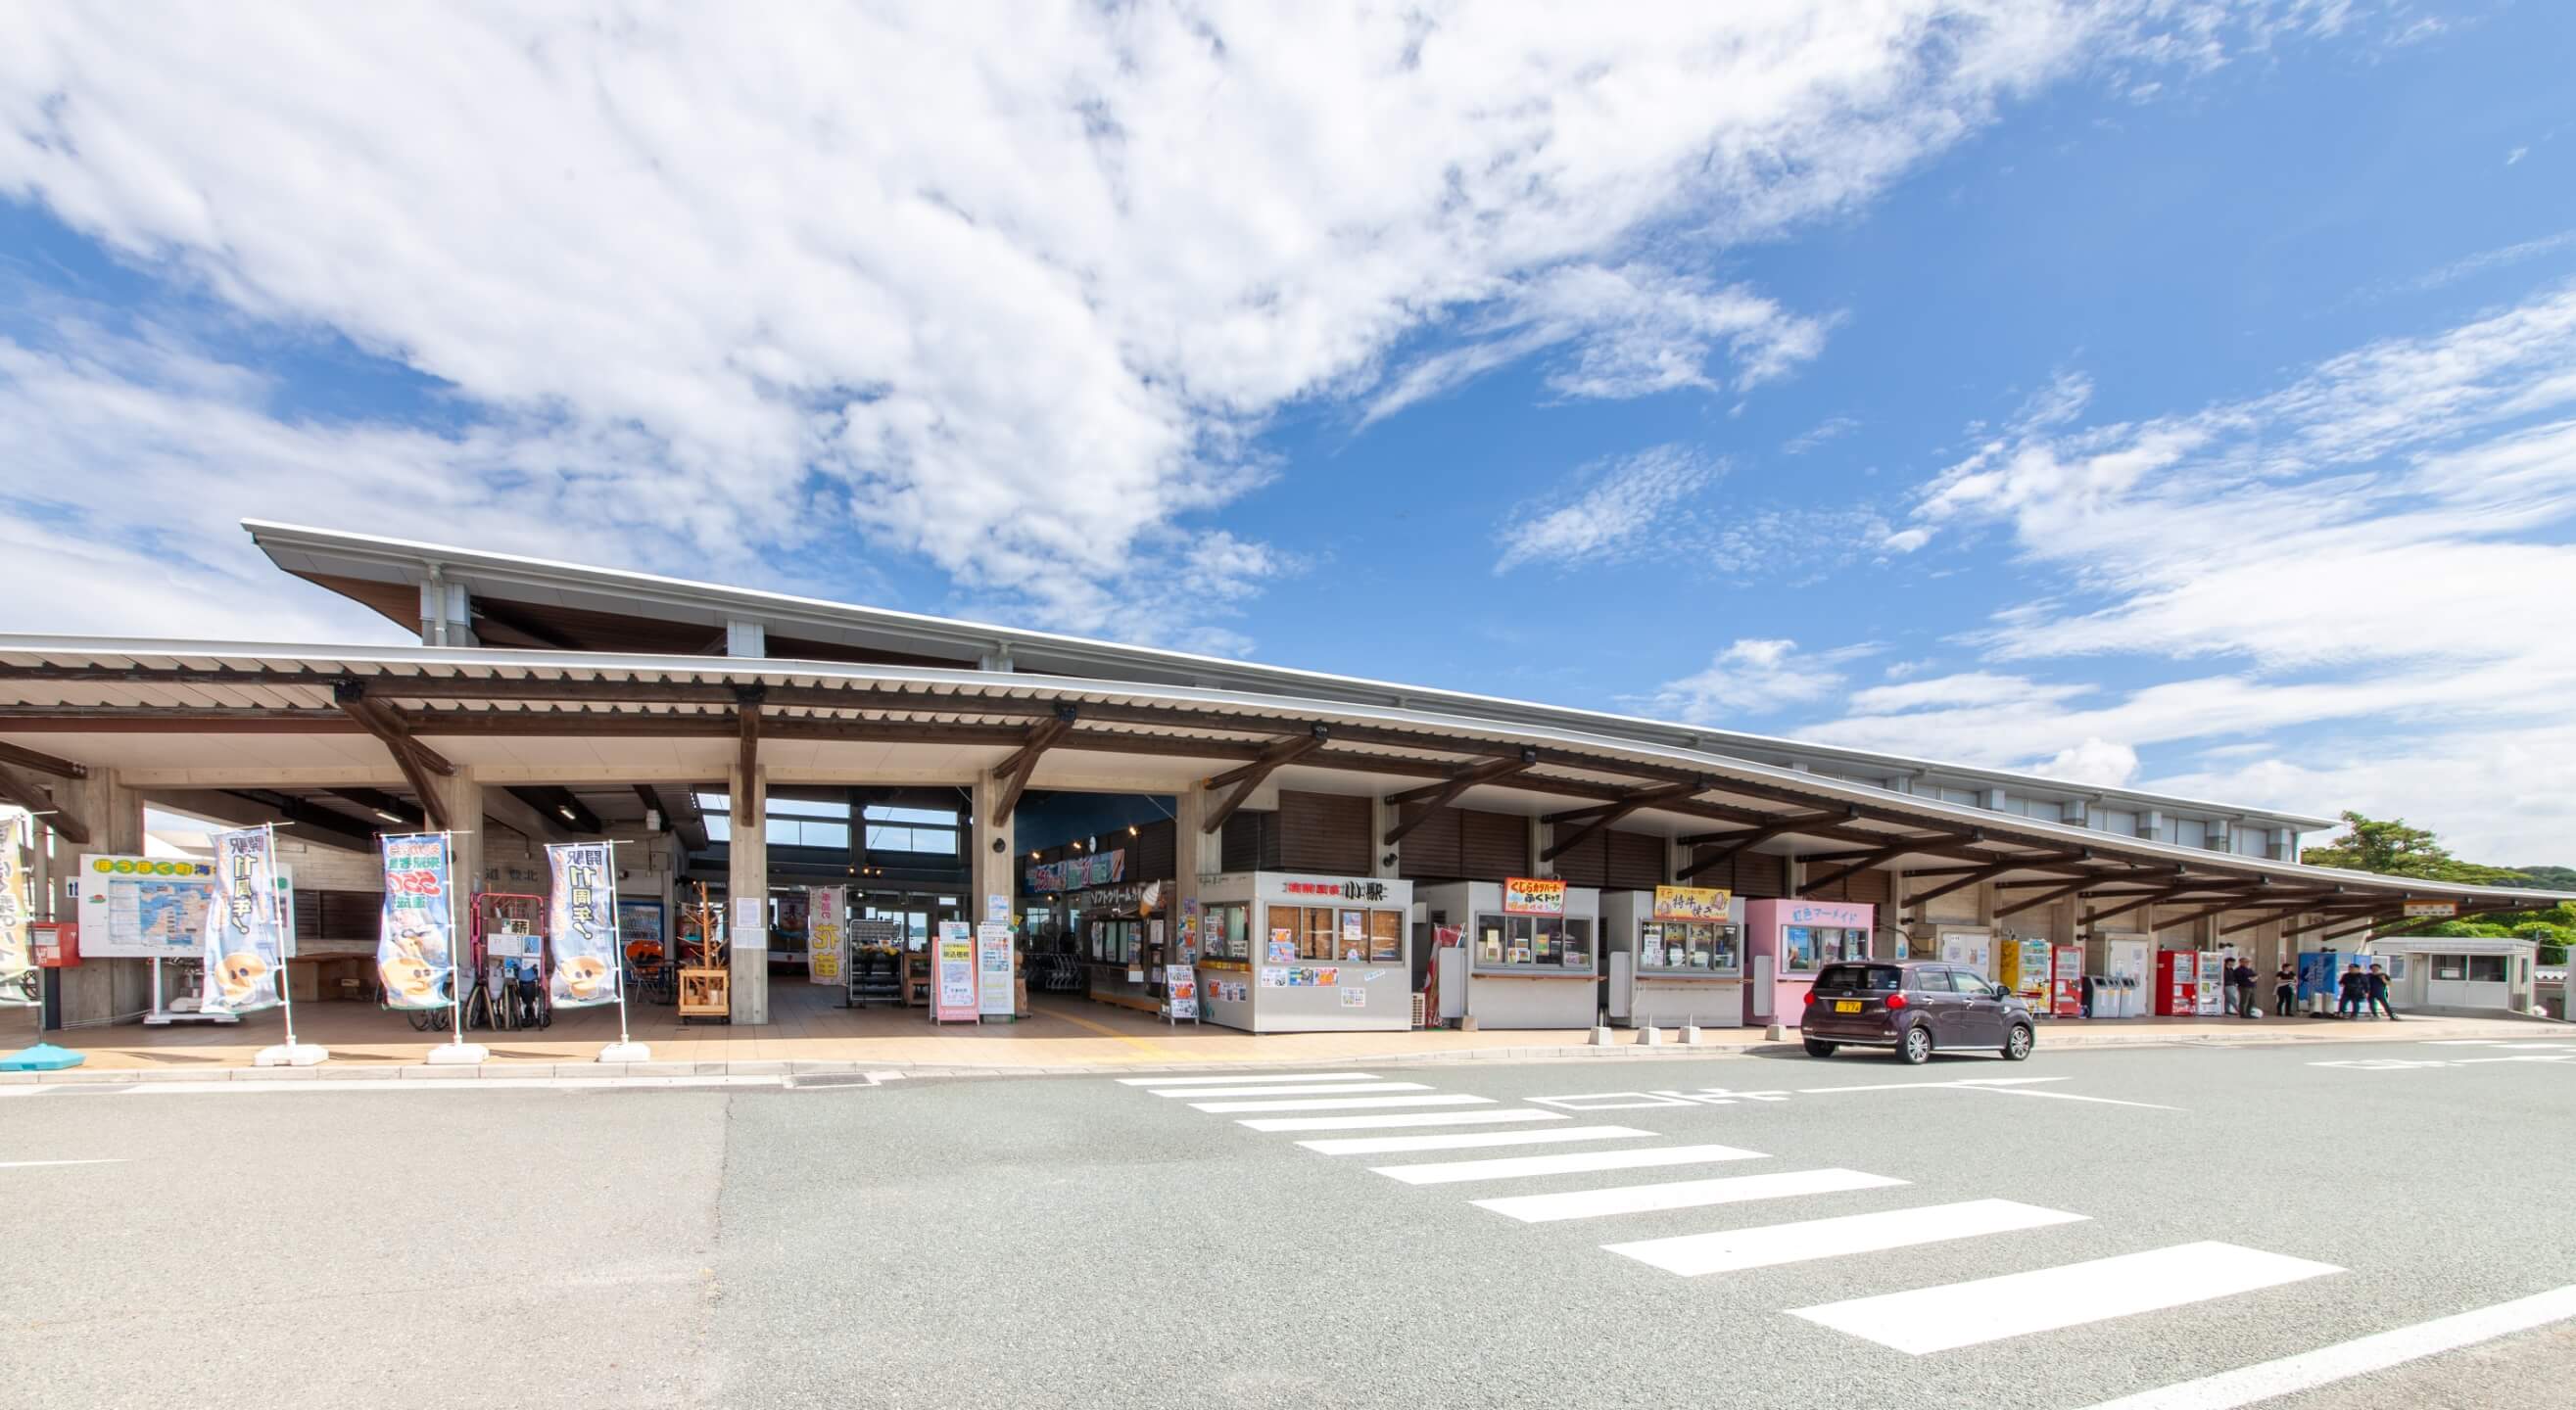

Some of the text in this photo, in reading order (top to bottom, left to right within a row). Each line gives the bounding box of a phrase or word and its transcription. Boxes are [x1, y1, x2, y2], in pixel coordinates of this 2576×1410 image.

[1792, 908, 1858, 924] 虹色マーメイド
